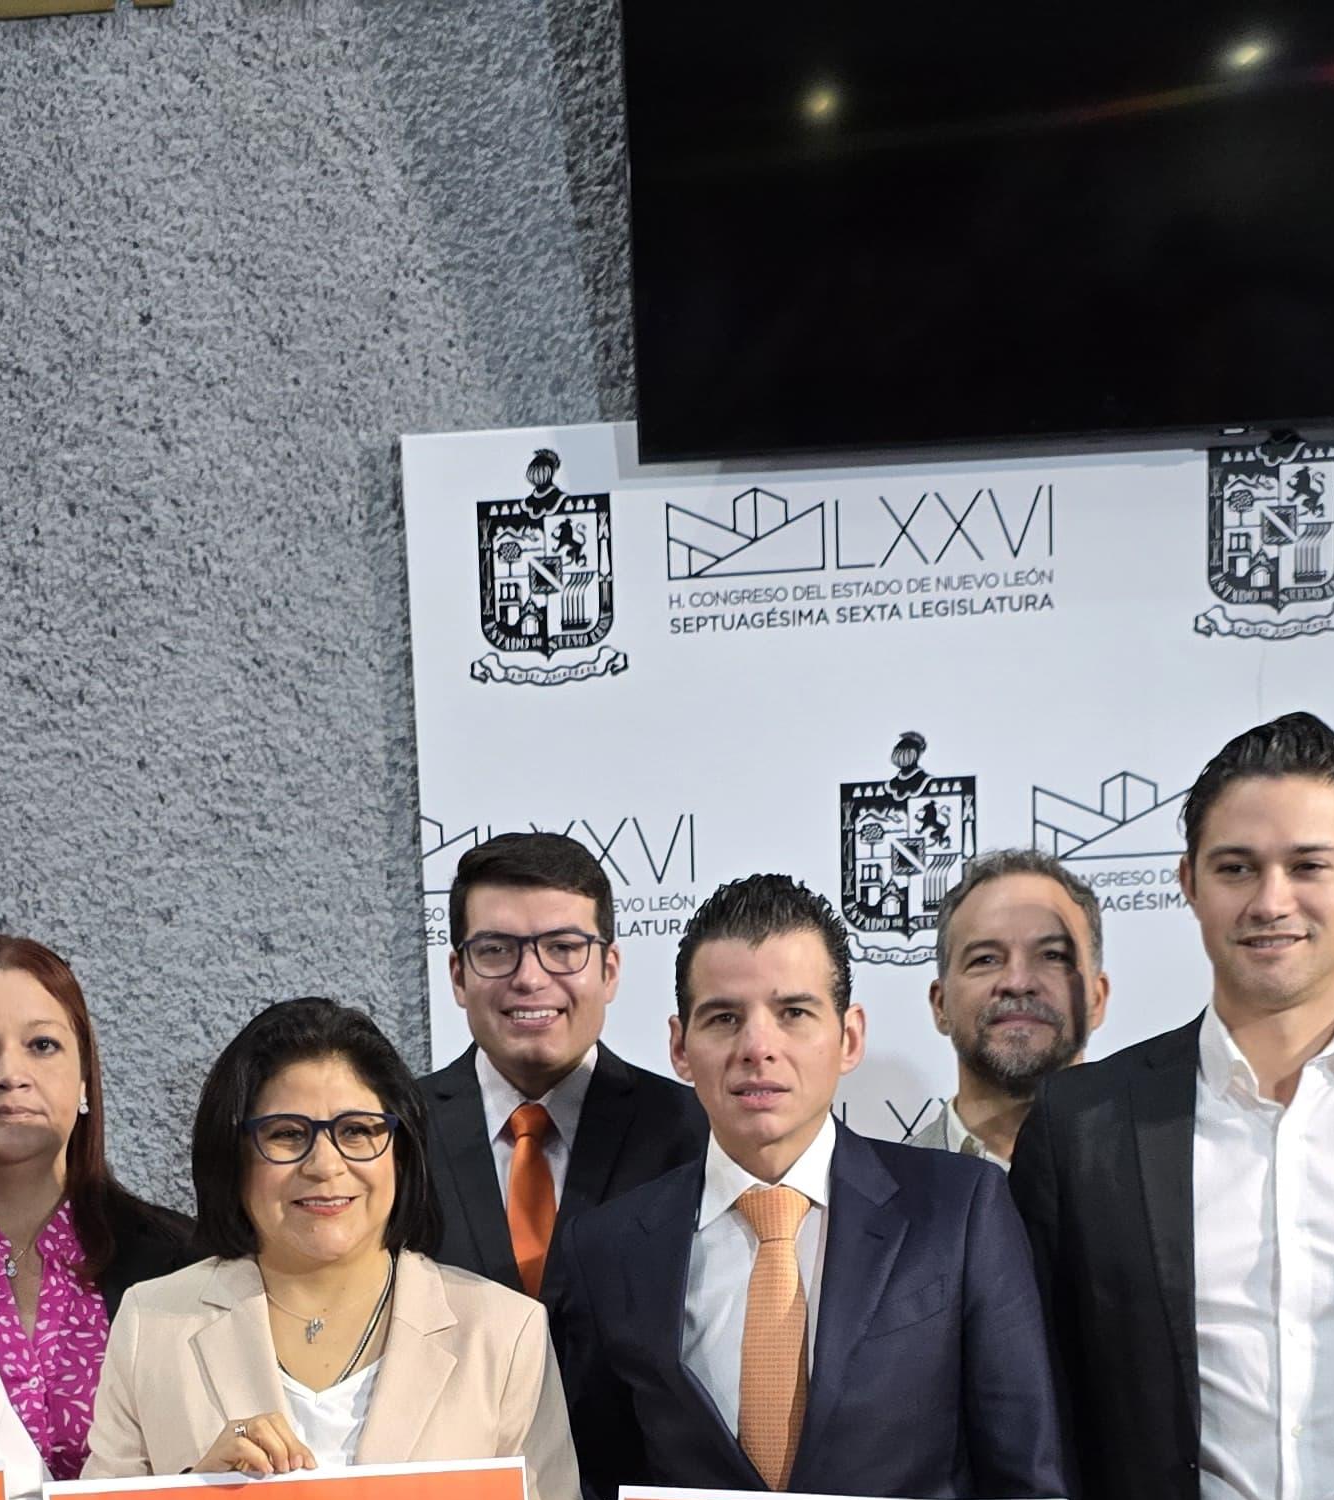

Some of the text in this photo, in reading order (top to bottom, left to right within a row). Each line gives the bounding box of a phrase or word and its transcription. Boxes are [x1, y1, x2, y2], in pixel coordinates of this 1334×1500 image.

[835, 484, 1053, 569] LXXVI
[669, 567, 1054, 609] H. CONGRESO DEL ESTADO DE NUEVO LEÓN
[670, 593, 1054, 634] SEPTUAGÉSIMA SEXTA LEGISLATURA
[613, 892, 695, 913] EVO LEÓN
